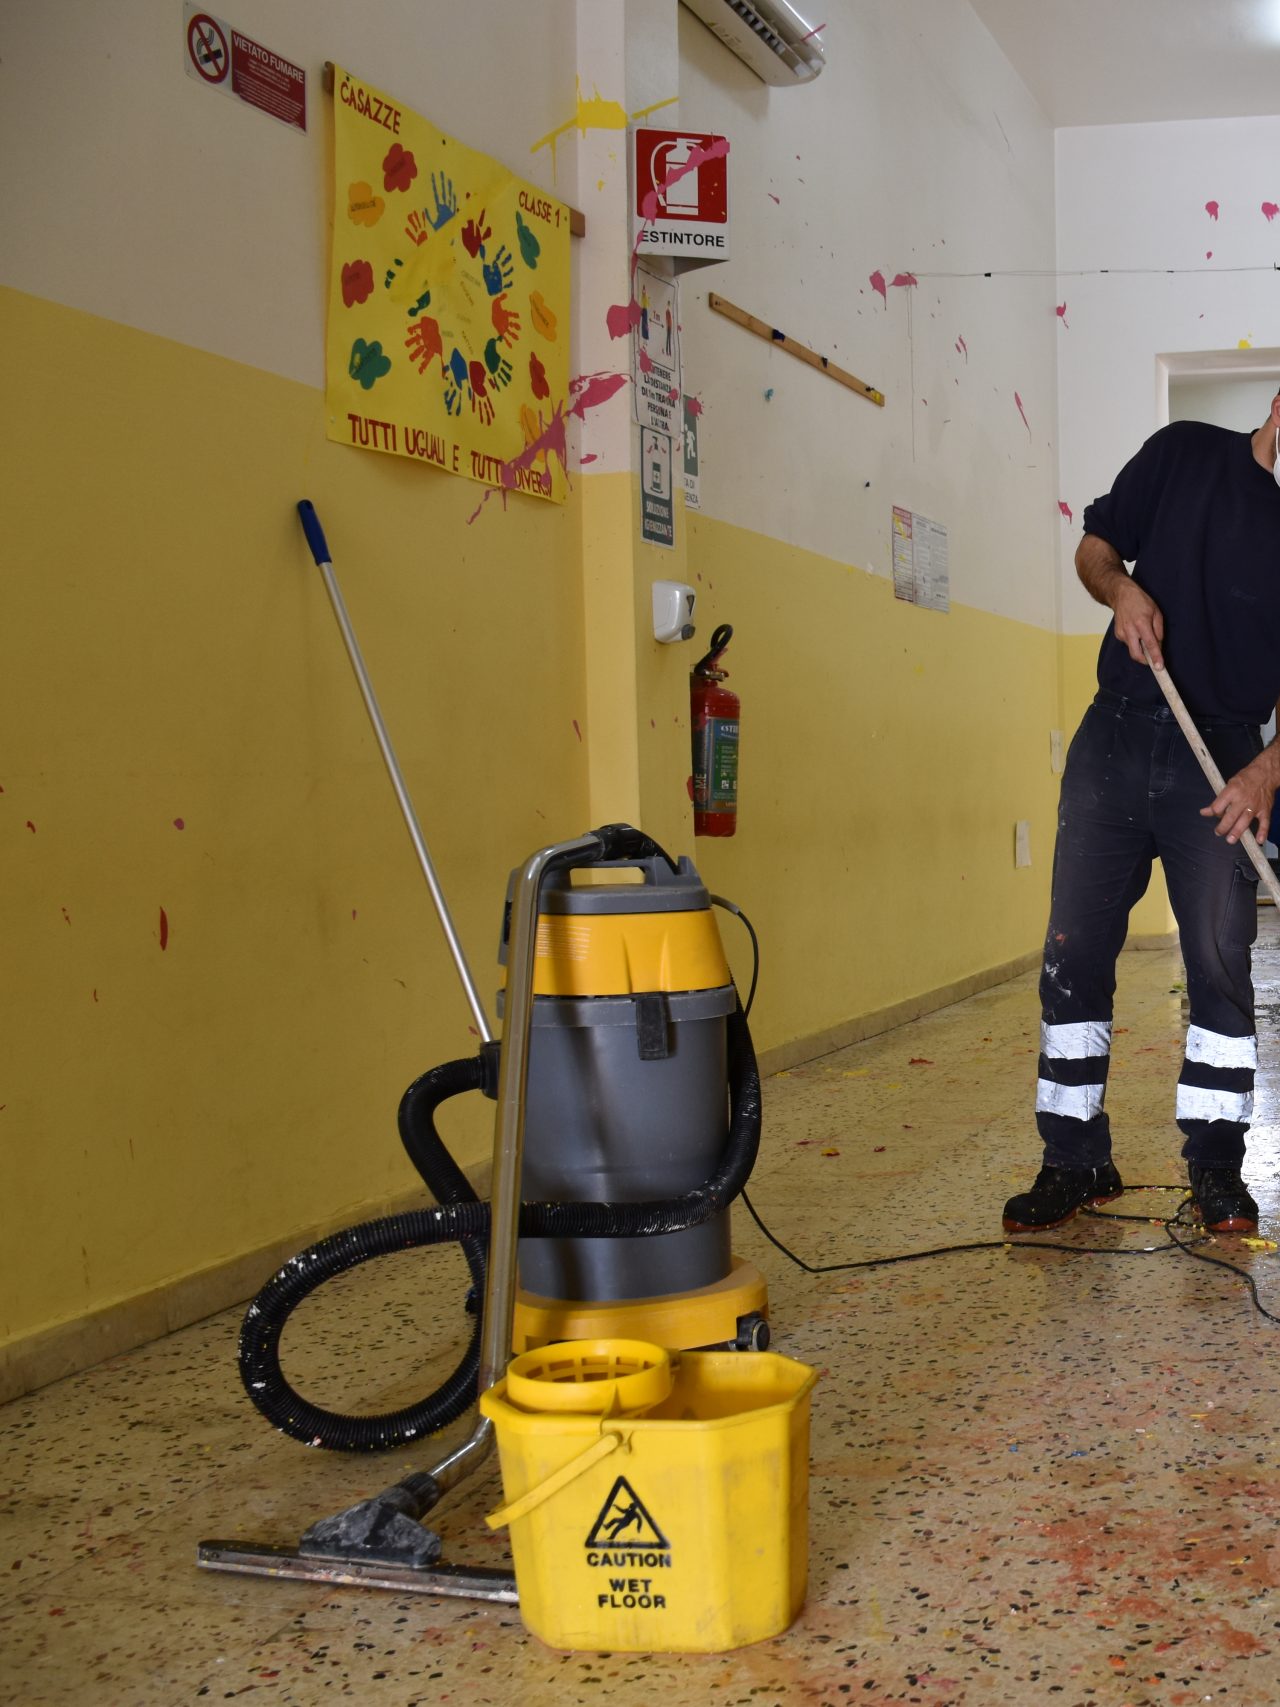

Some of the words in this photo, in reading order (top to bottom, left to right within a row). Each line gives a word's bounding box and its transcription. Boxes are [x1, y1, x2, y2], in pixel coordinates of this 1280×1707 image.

[233, 34, 268, 63] VIETATO
[270, 56, 304, 84] FUMARE
[340, 81, 401, 135] CASAZZE
[518, 190, 552, 223] CLASSE
[555, 208, 560, 228] 1
[641, 230, 725, 248] ESTINTORE
[348, 413, 397, 451] TUTTI
[405, 426, 446, 466] UGUALI
[453, 444, 459, 473] E
[470, 450, 505, 484] TUTT
[586, 1552, 672, 1568] CAUTION
[609, 1578, 652, 1593] WET
[598, 1594, 666, 1609] FLOOR
